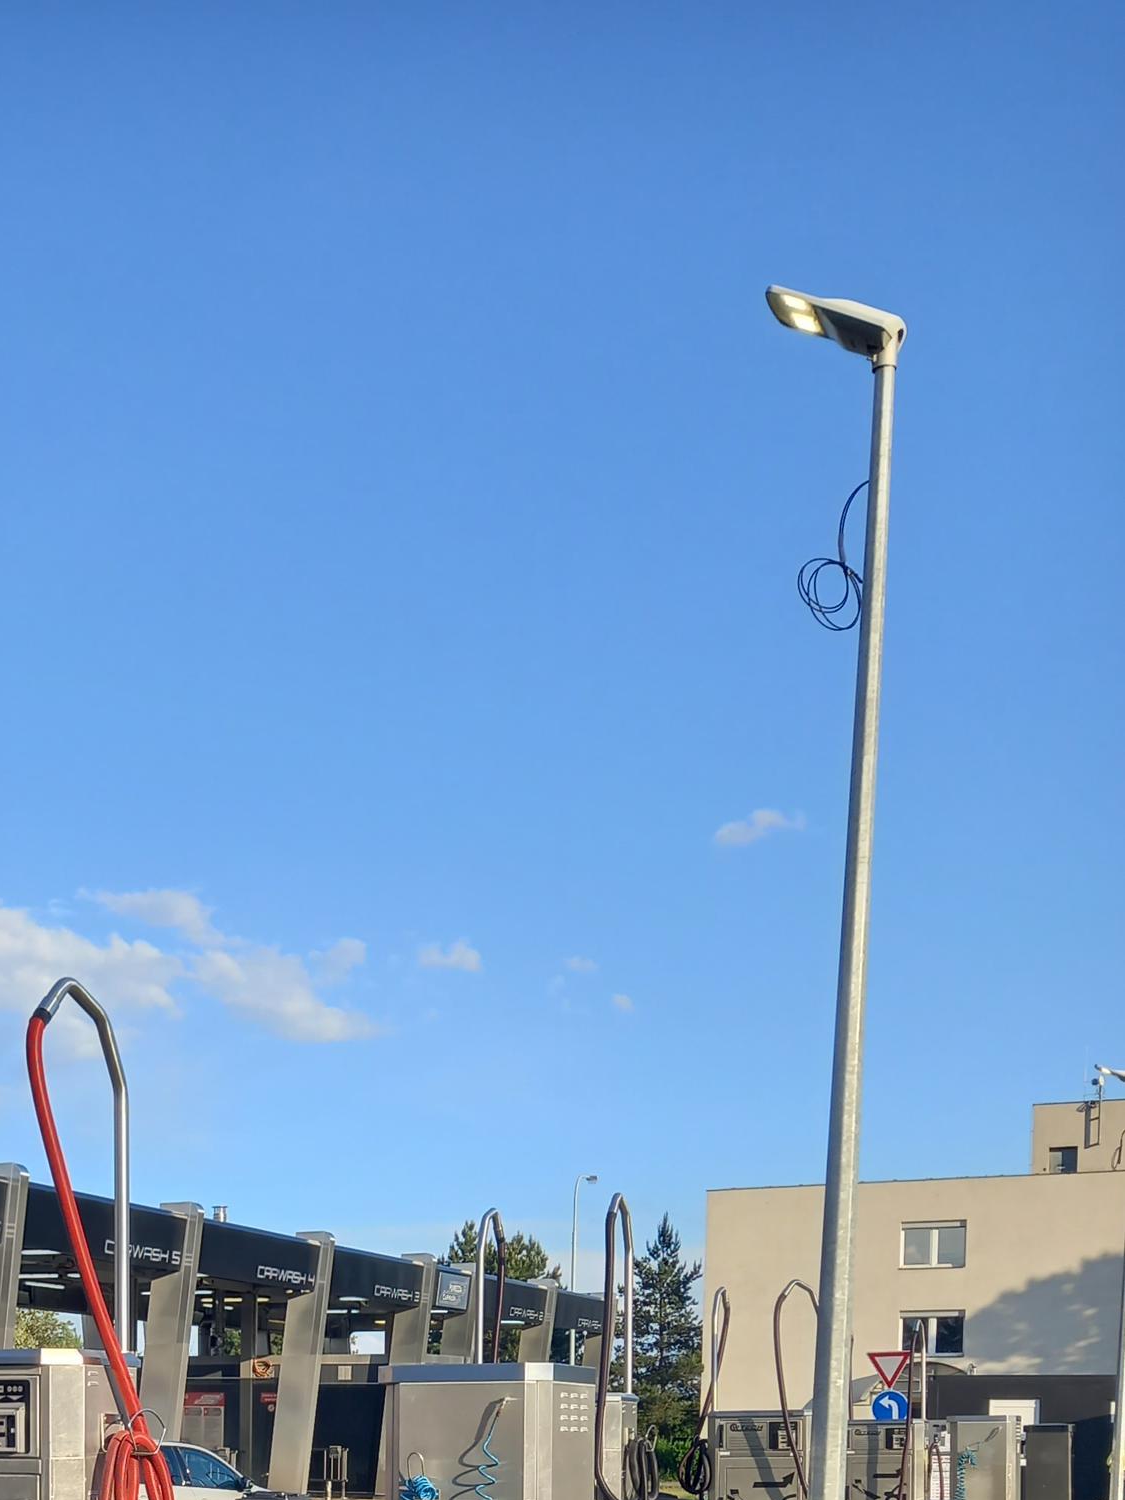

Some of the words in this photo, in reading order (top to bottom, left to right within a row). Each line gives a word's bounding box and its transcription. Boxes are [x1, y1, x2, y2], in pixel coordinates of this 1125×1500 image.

[104, 1239, 169, 1263] CWASH
[171, 1250, 181, 1265] 5
[257, 1265, 306, 1285] CARWASH
[308, 1273, 315, 1287] 4
